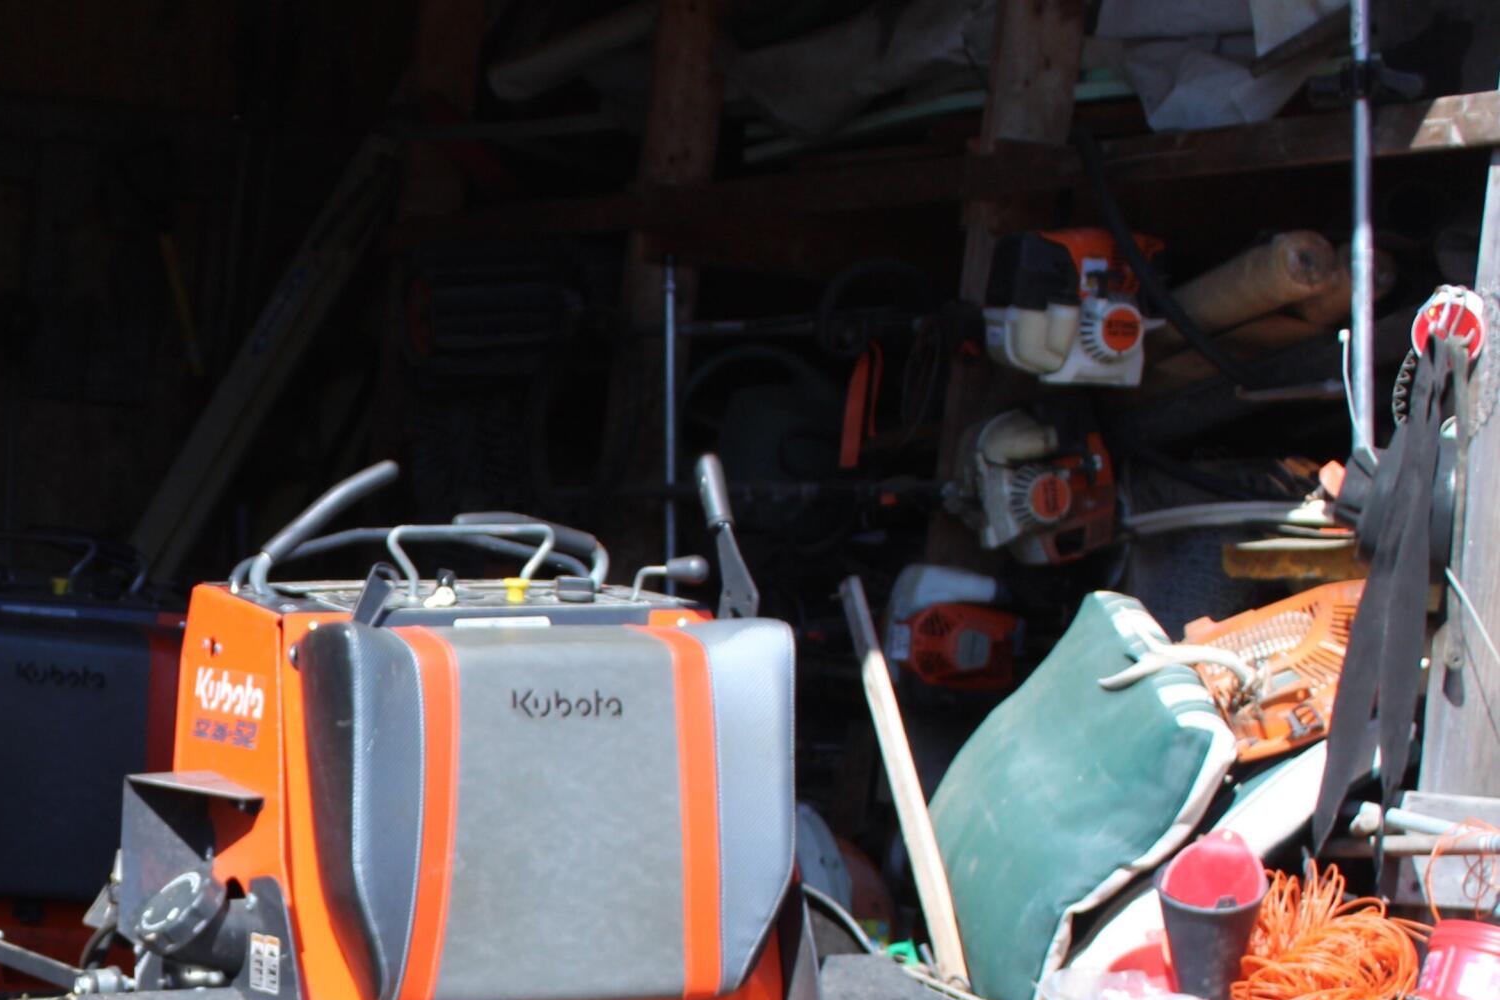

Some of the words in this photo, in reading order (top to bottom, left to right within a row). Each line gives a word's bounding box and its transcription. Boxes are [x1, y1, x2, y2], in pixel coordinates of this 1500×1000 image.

[16, 661, 106, 690] Kubota
[195, 667, 264, 720] Kubota
[511, 689, 623, 718] Kubota
